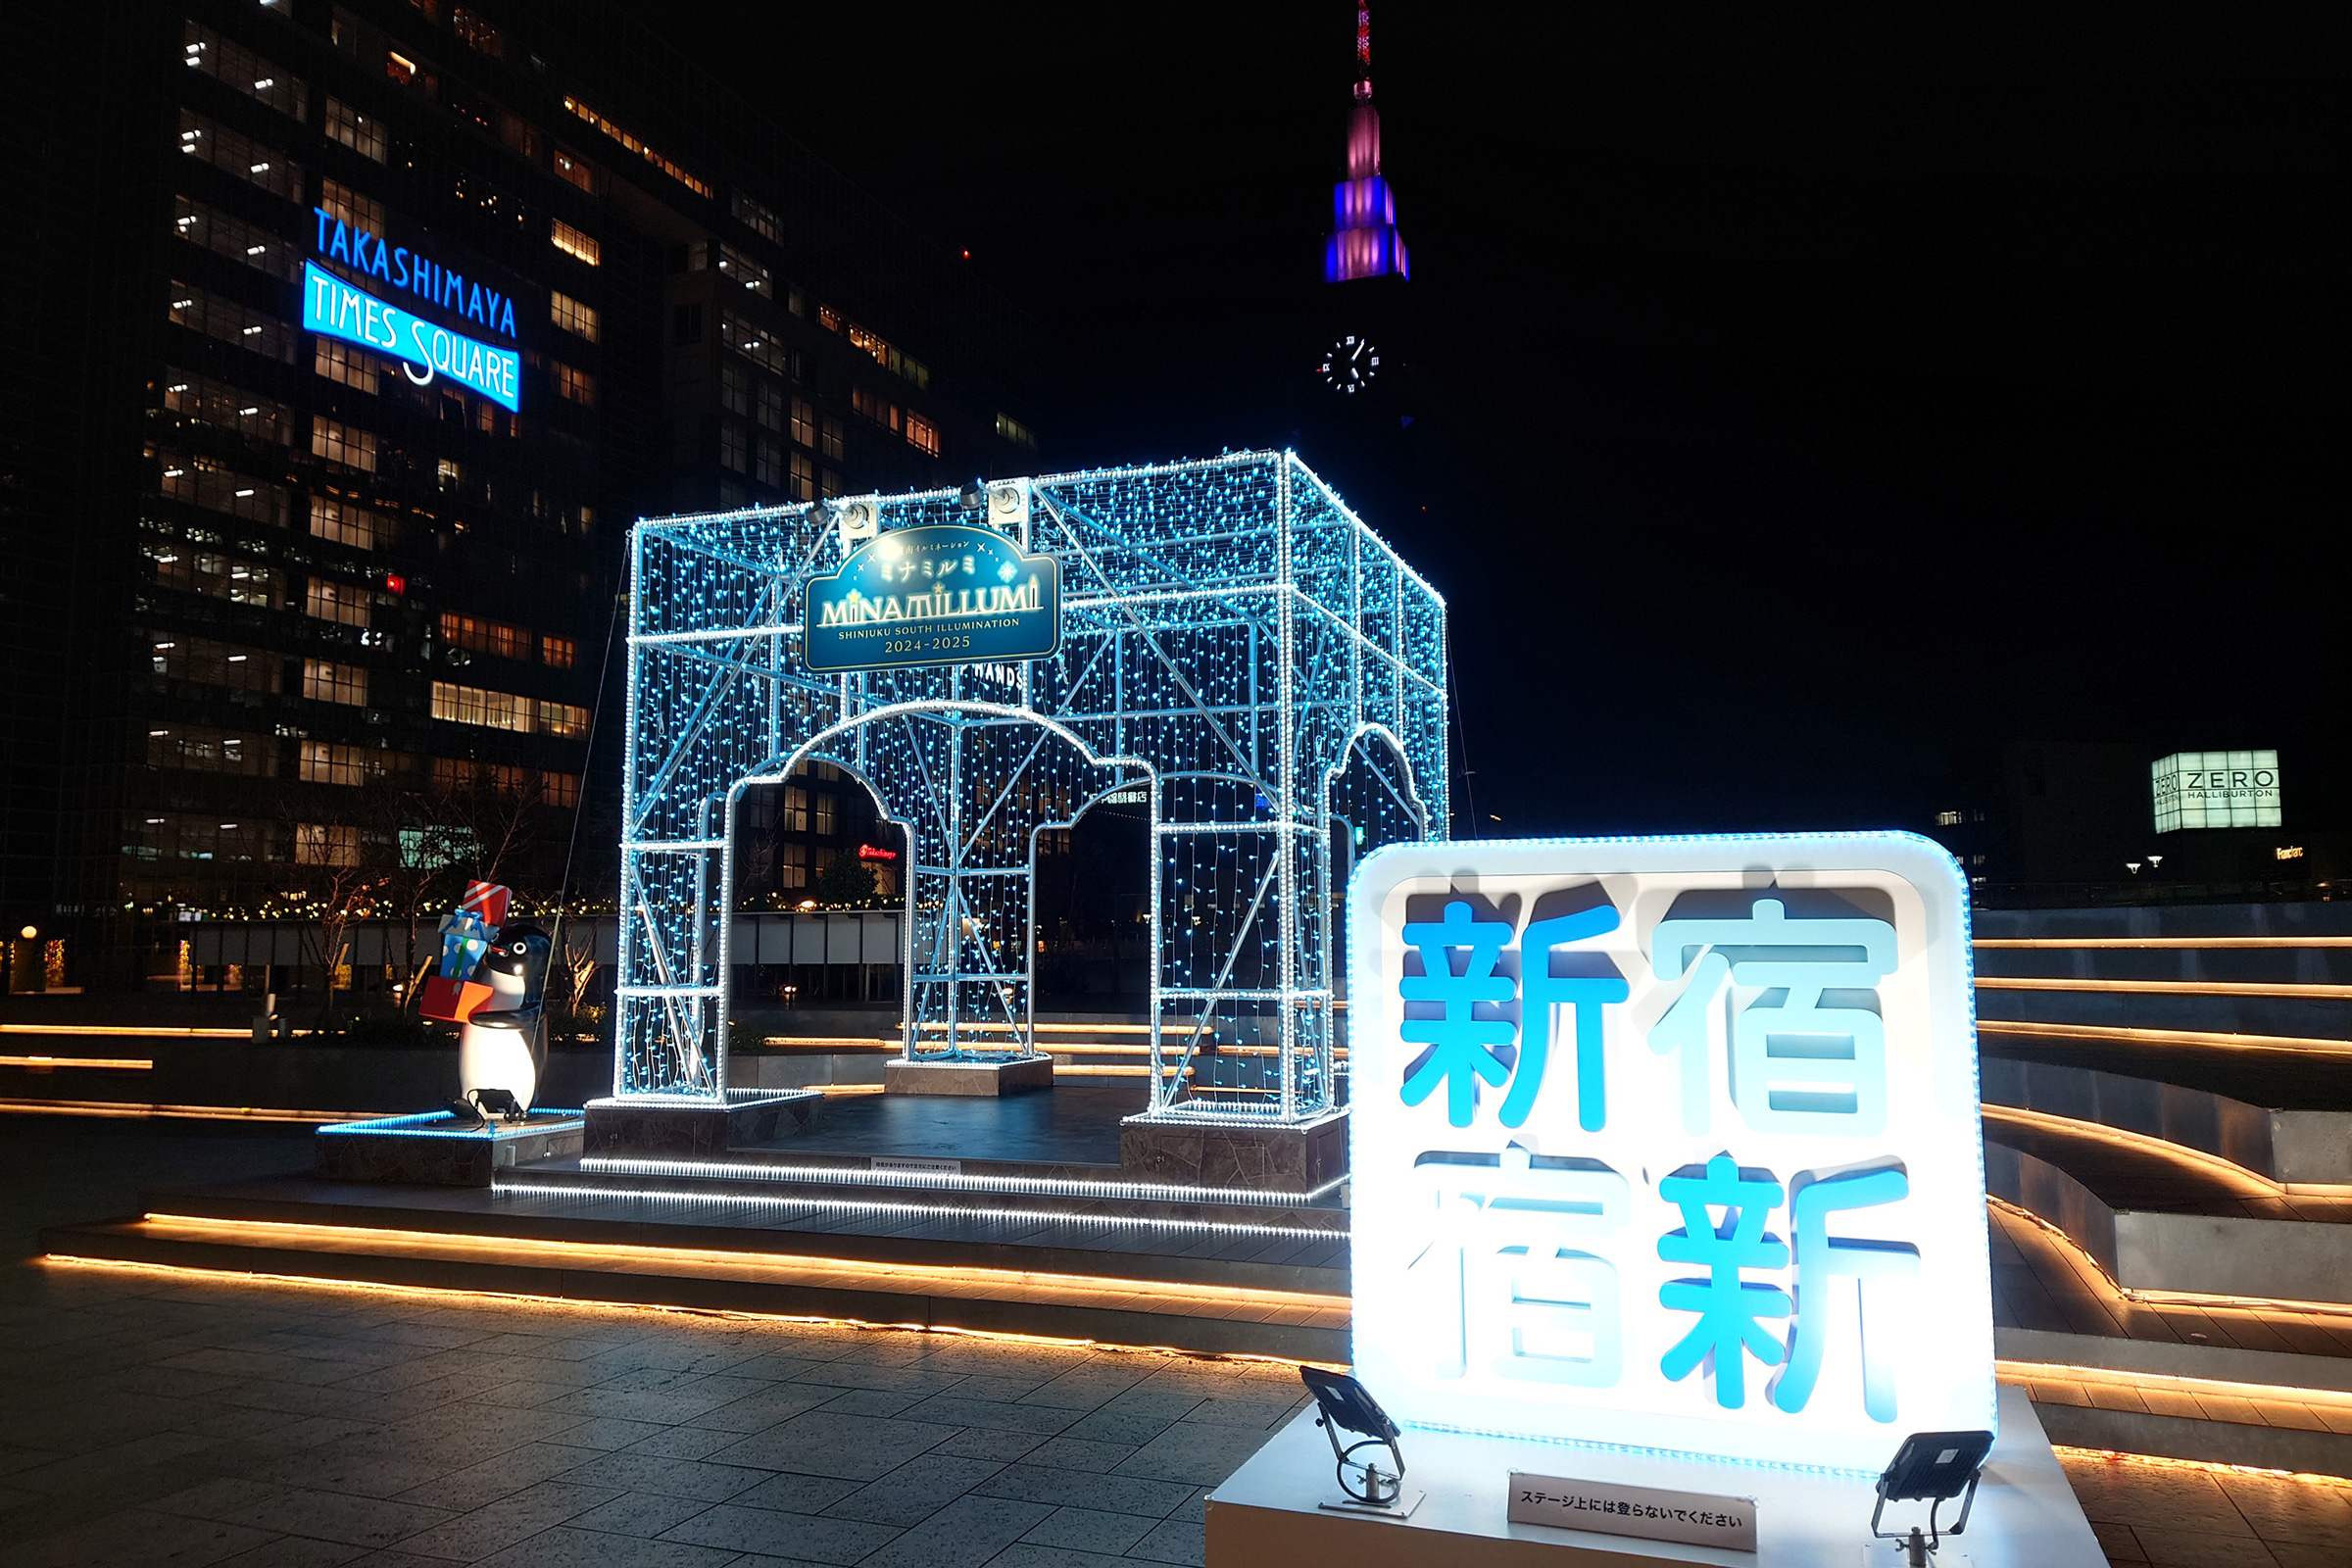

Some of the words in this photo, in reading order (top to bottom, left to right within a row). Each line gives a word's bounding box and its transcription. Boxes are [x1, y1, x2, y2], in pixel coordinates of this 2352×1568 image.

[314, 207, 516, 339] TAKASHIMAYA
[312, 275, 397, 348] TIMES
[403, 320, 514, 399] SQUARE
[882, 556, 975, 581] ミナミルミ
[838, 627, 891, 640] SHINJUKU
[895, 624, 933, 635] SOUTH
[937, 617, 1020, 633] ILLUMINATION
[885, 635, 971, 654] 2024-2025
[2155, 774, 2178, 797] ZERO
[2187, 770, 2275, 789] ZERO
[2187, 789, 2274, 799] HALLIBURTON
[1399, 899, 1899, 1138] 新宿
[1520, 1490, 1742, 1529] ステージ上には登らないでください
